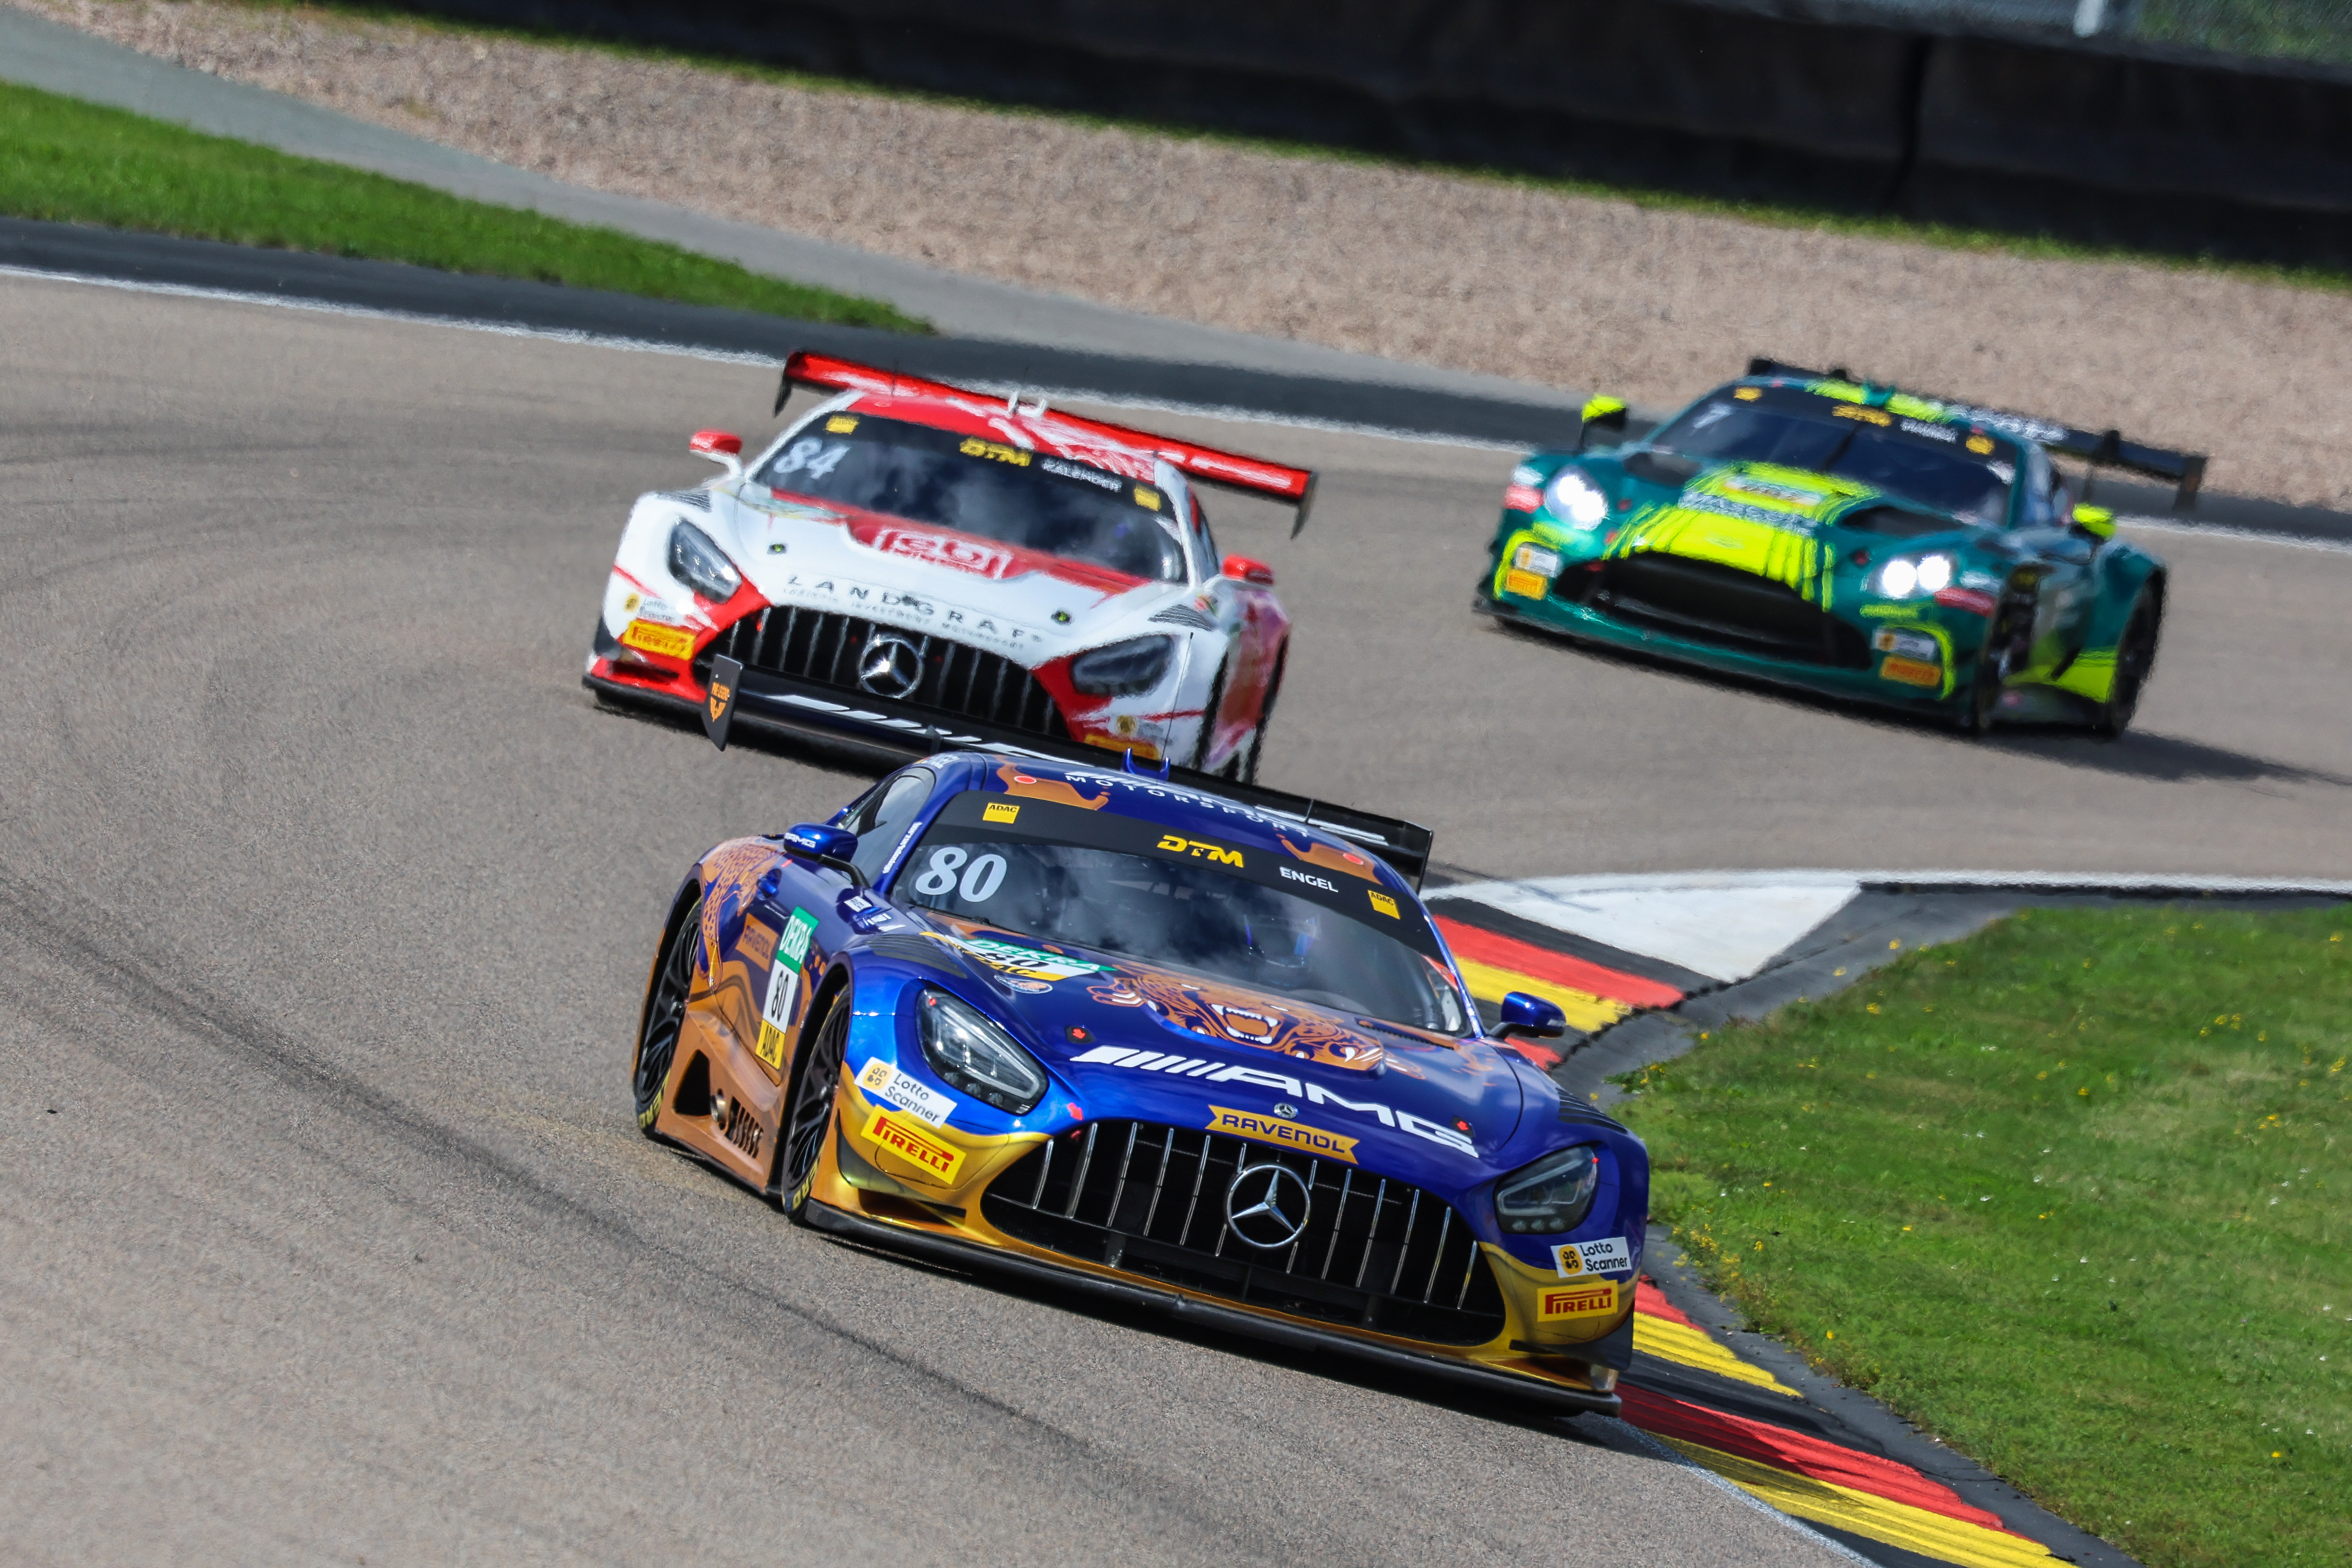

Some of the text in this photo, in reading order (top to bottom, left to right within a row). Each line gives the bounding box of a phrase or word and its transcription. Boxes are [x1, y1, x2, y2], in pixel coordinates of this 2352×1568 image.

[773, 437, 852, 480] 84
[788, 575, 1025, 638] LANDGRAF
[988, 804, 1018, 814] ADAC
[1065, 774, 1310, 838] MOTORSPORT
[1157, 834, 1244, 868] DTM
[915, 846, 1007, 902] 80
[1279, 866, 1338, 893] ENGEL
[1370, 891, 1394, 906] ADAC
[779, 914, 813, 964] DEKRA
[967, 939, 1100, 971] DEKRA
[974, 951, 1050, 968] 80
[771, 969, 789, 1022] 80
[884, 1086, 941, 1124] Scanner
[892, 1074, 929, 1101] Lotto
[1206, 1065, 1479, 1158] AMG
[873, 1116, 954, 1173] PIRELLI
[1222, 1113, 1347, 1154] RAVENOL
[1579, 1242, 1613, 1258] Lotto
[1585, 1255, 1628, 1272] Scanner
[1545, 1288, 1612, 1314] PIRELLI
